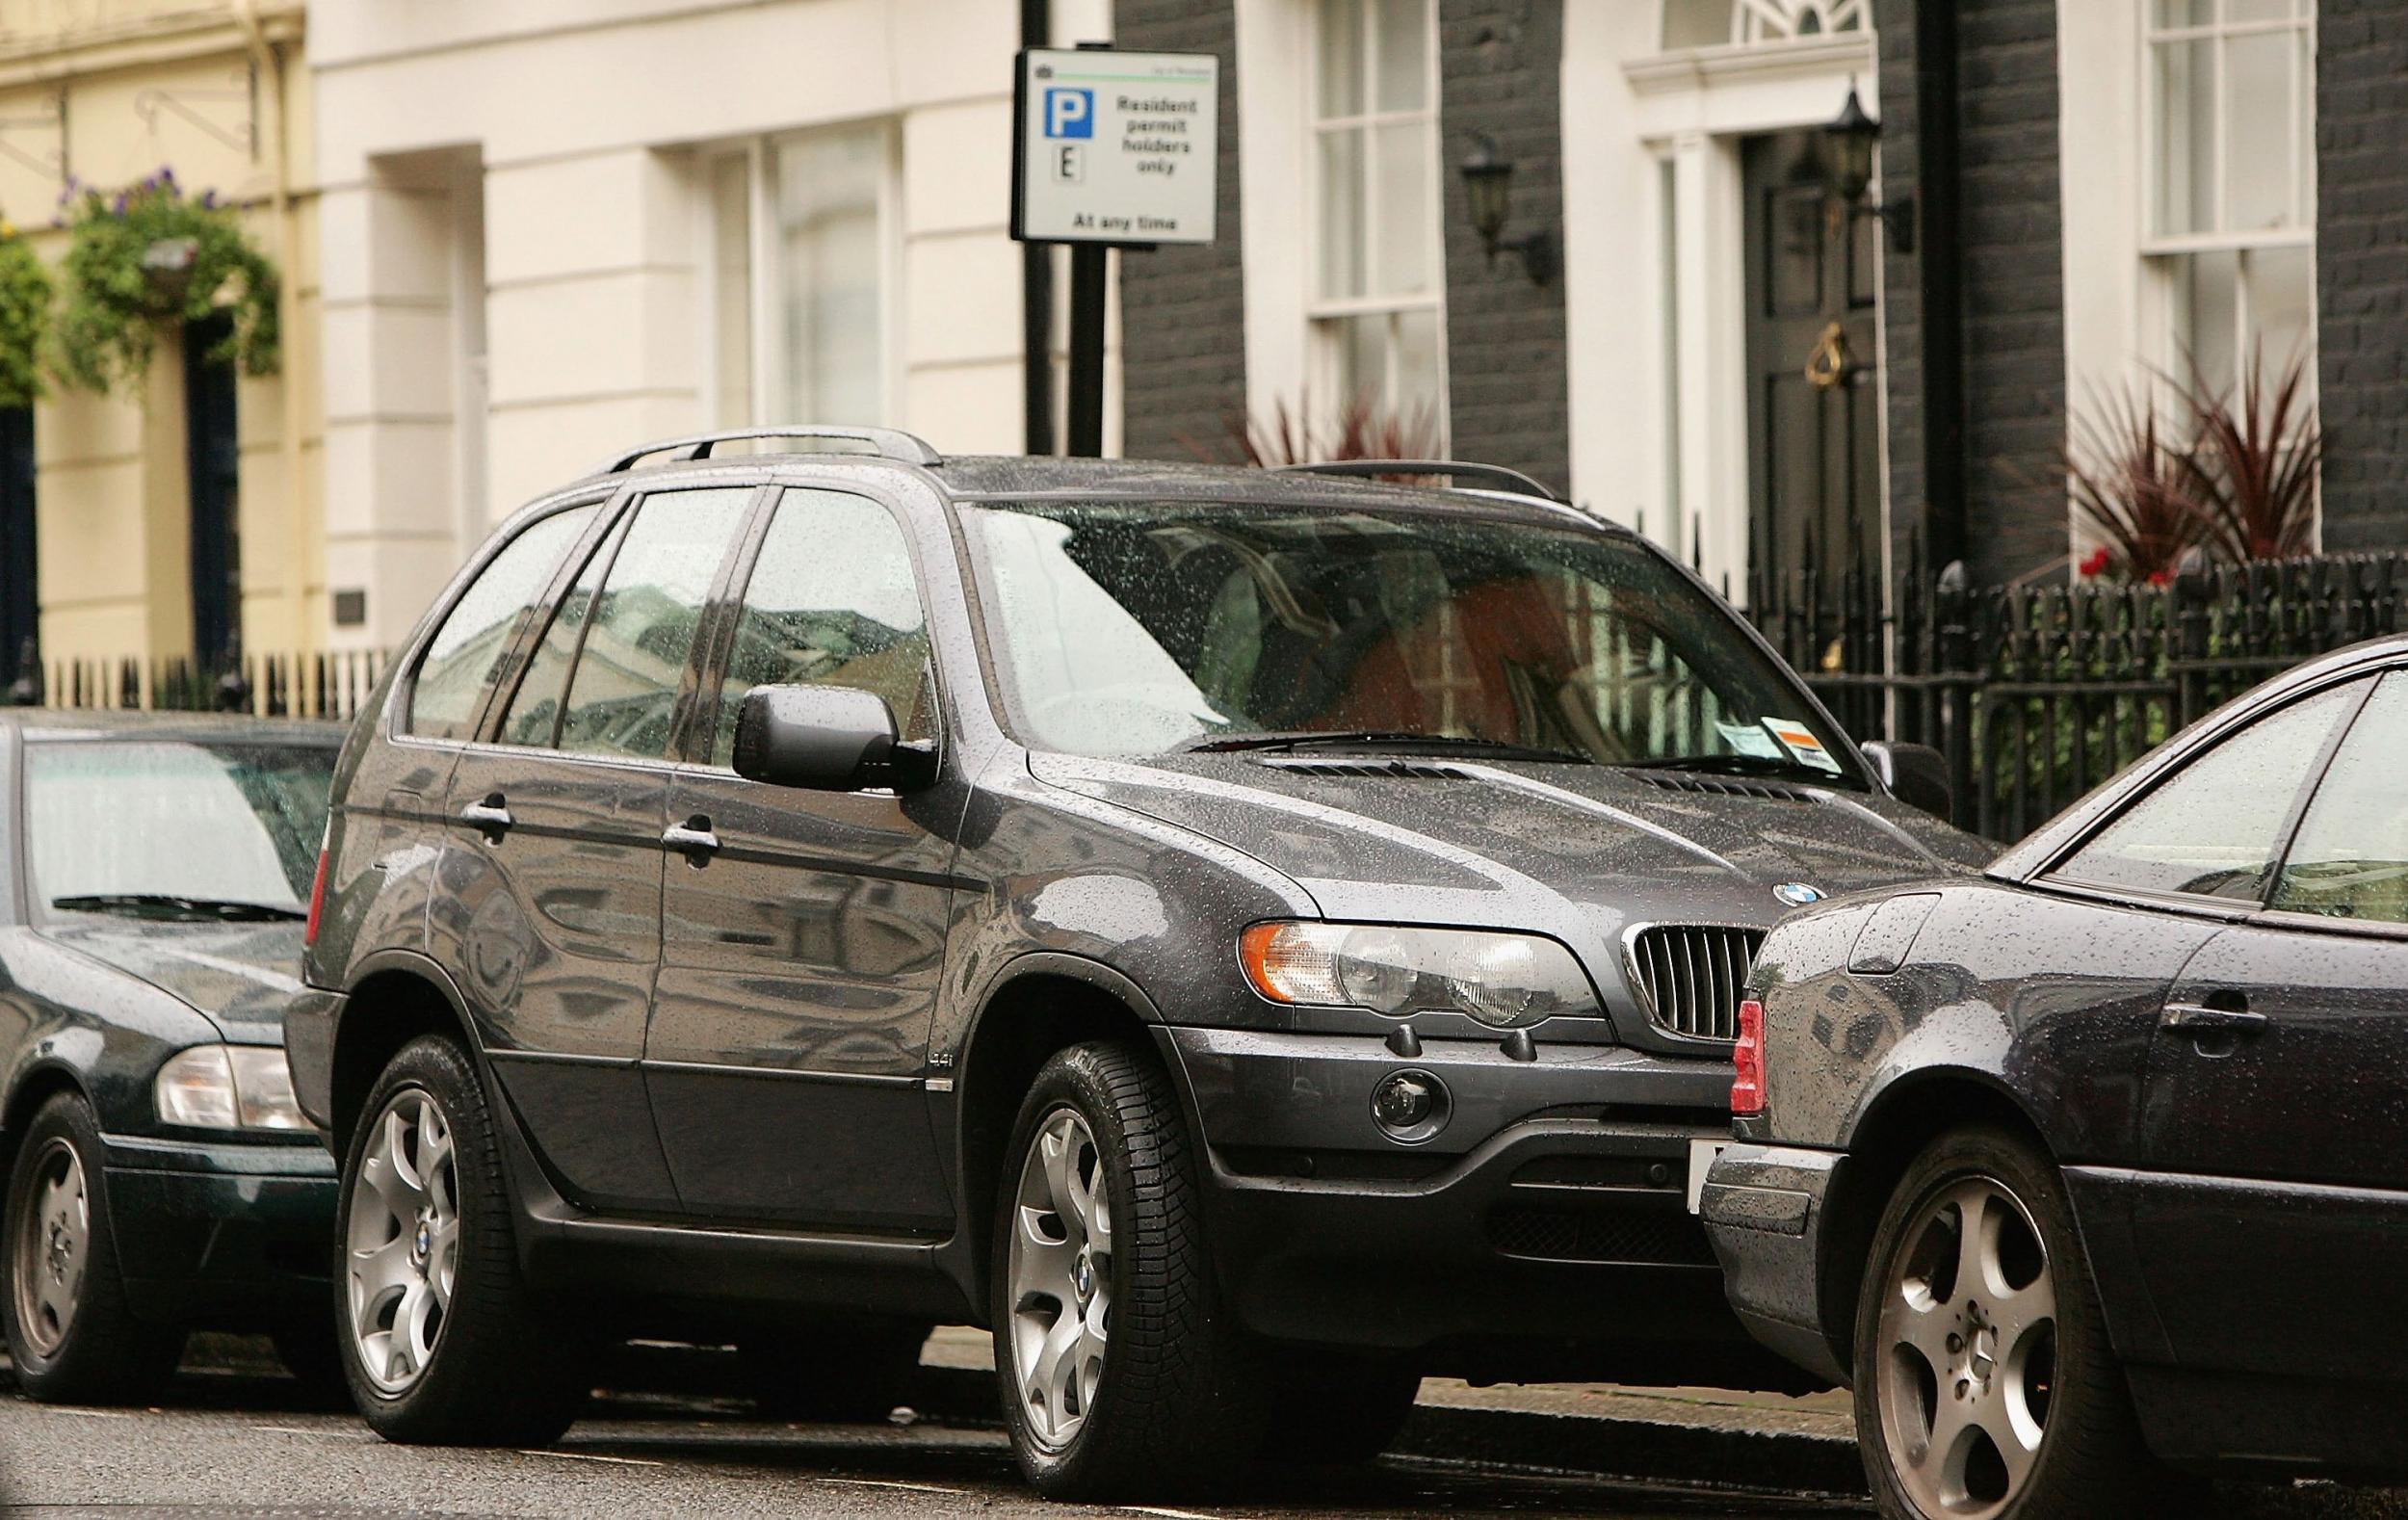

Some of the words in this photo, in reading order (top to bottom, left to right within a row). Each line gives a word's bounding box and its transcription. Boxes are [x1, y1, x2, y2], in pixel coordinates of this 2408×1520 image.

[1052, 92, 1086, 135] P
[1117, 95, 1196, 114] Resident
[1126, 118, 1188, 134] permit
[1122, 138, 1191, 155] holders
[1060, 146, 1074, 177] E
[1137, 158, 1174, 176] only
[1073, 213, 1094, 227] At
[1100, 217, 1131, 232] any
[1138, 216, 1177, 231] time
